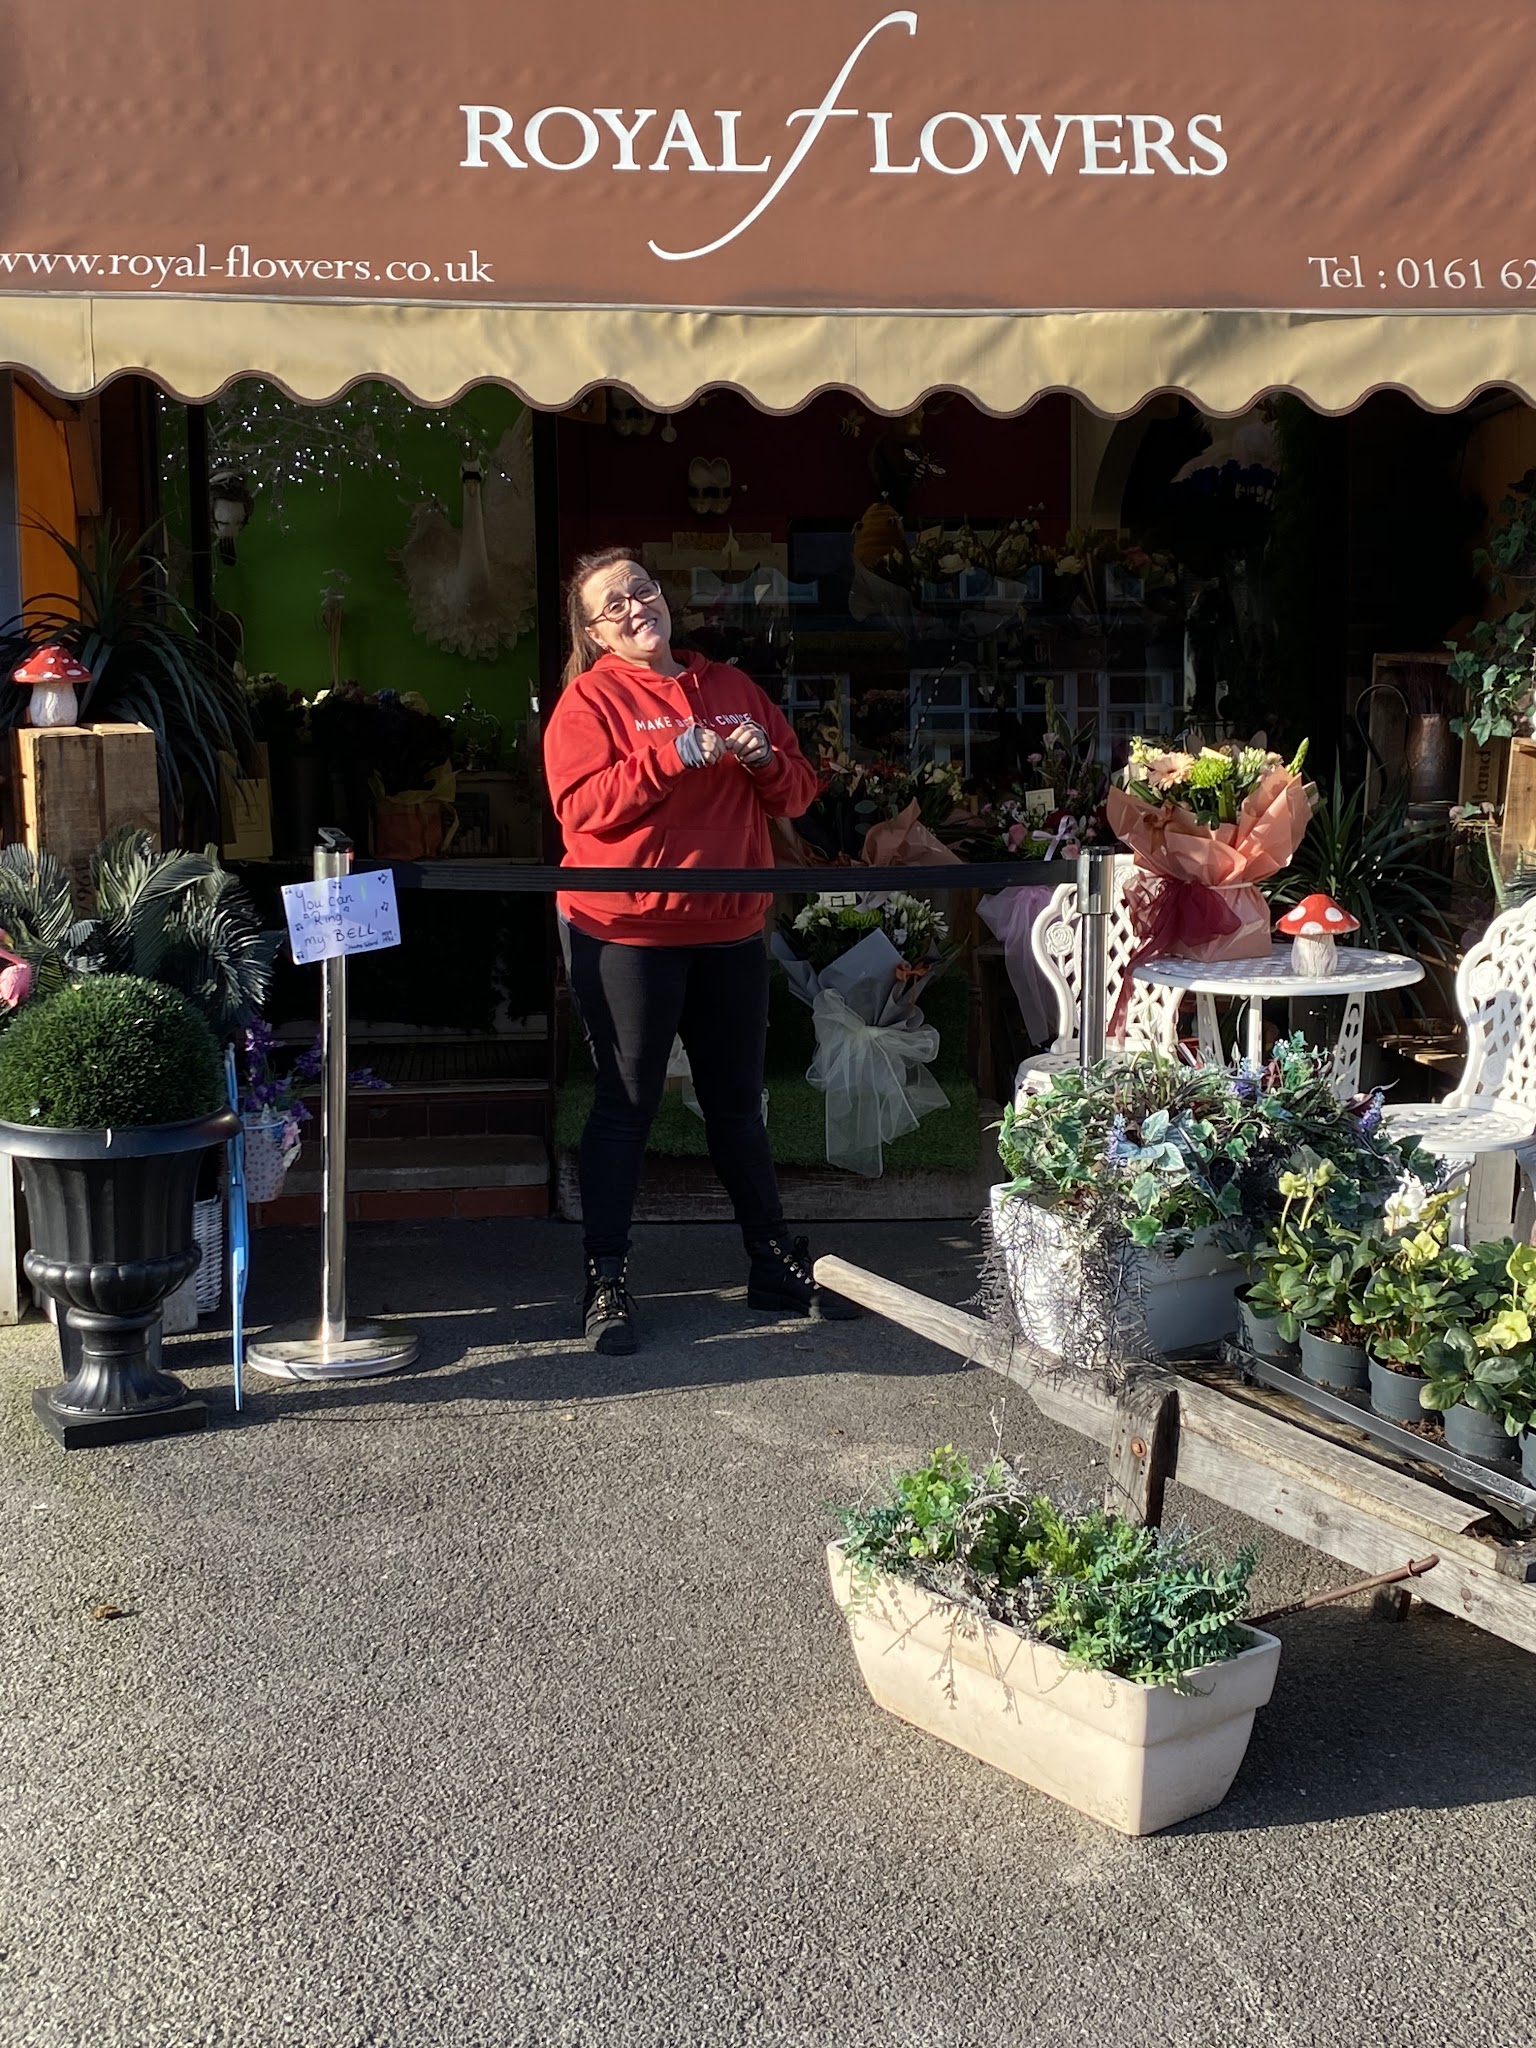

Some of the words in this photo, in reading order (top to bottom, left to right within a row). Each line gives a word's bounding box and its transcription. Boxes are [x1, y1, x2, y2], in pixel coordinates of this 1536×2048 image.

[459, 104, 772, 172] ROYAL
[0, 244, 494, 288] www.royal-flowers.co.uk
[1397, 257, 1485, 289] 0161
[635, 716, 673, 732] MAKE
[311, 910, 343, 926] Ring
[332, 923, 374, 941] BELL
